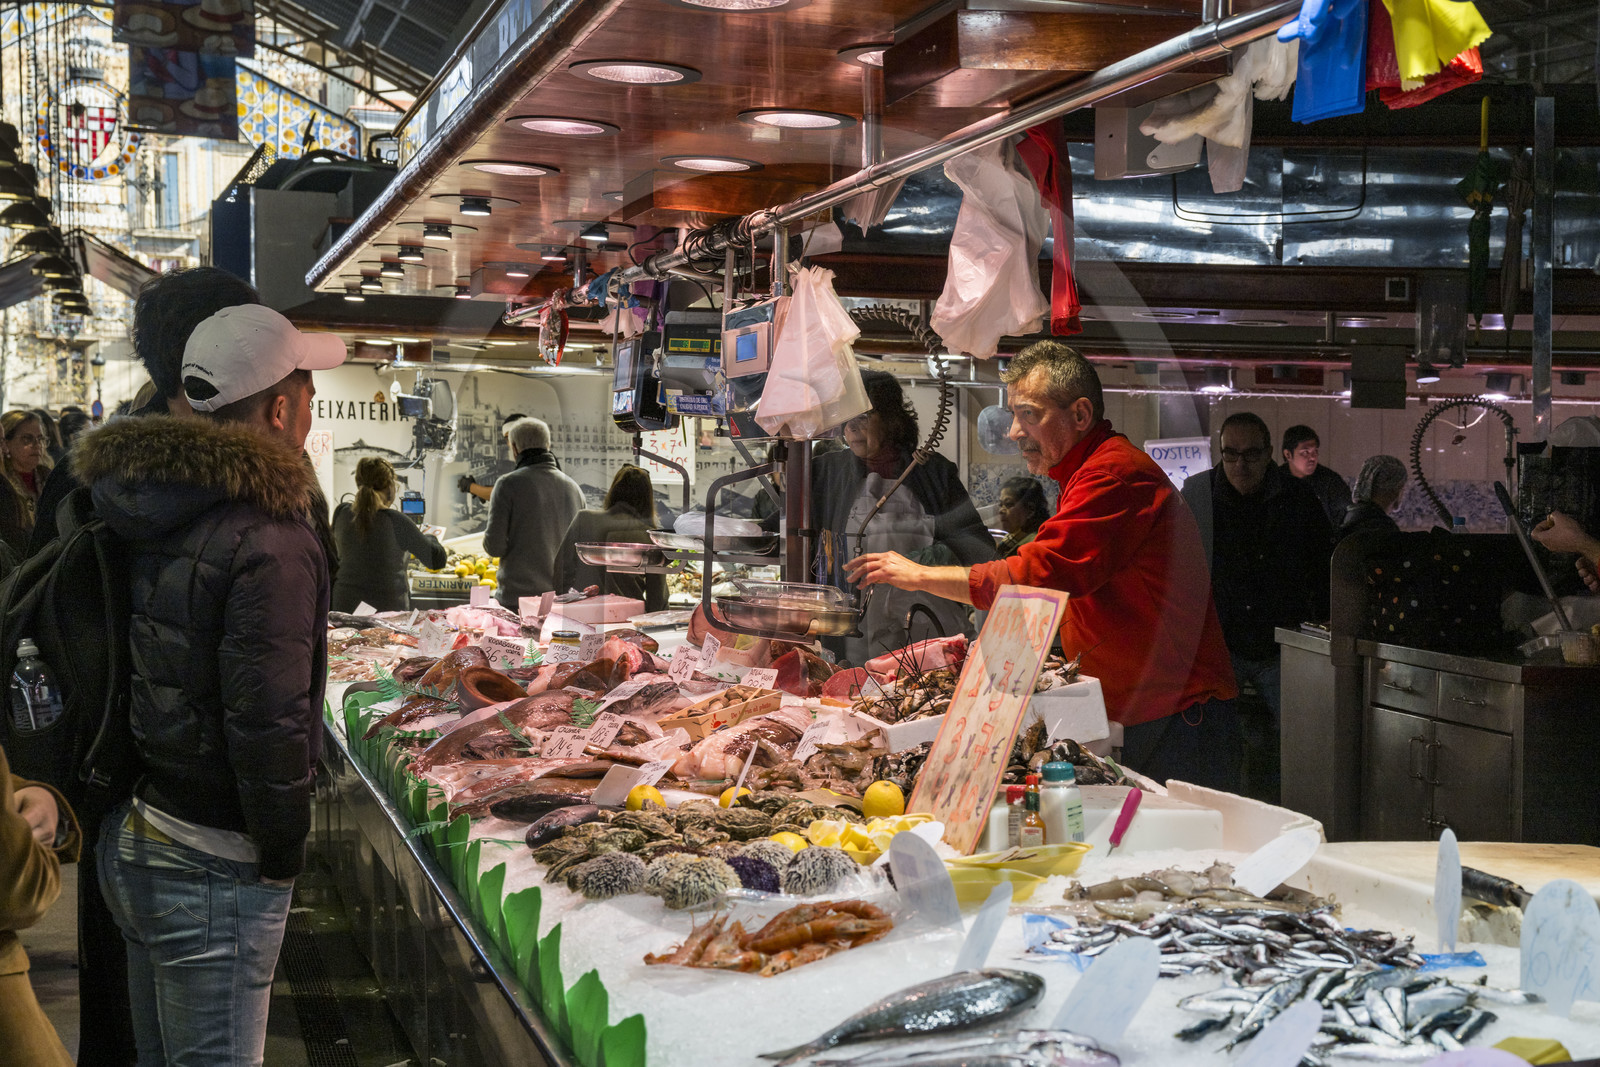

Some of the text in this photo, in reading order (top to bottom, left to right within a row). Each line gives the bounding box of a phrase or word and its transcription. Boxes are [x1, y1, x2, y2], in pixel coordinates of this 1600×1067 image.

[1151, 446, 1202, 460] OYSTER
[418, 579, 473, 590] MARINTER
[992, 605, 1051, 653] OSTRAS
